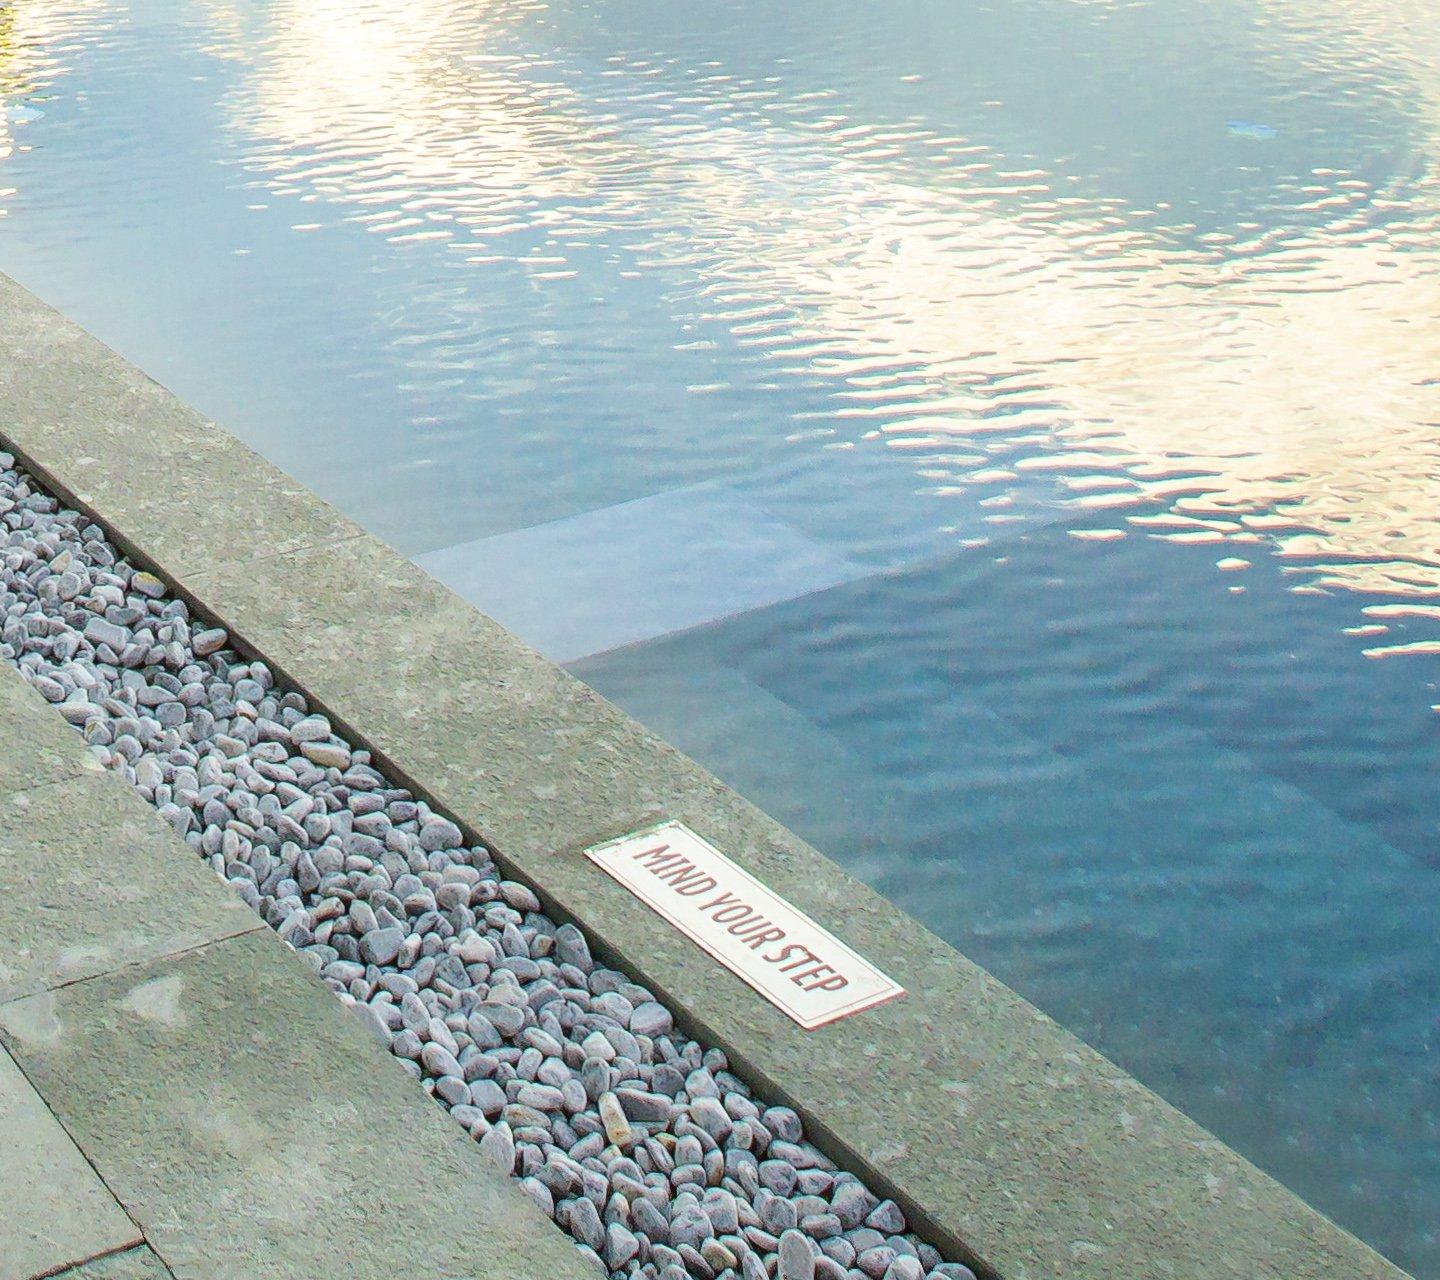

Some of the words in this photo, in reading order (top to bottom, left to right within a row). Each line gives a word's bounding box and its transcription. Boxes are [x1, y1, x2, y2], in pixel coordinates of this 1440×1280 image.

[632, 844, 717, 896] MIND
[697, 891, 787, 950] YOUR
[761, 944, 849, 992] STEP
